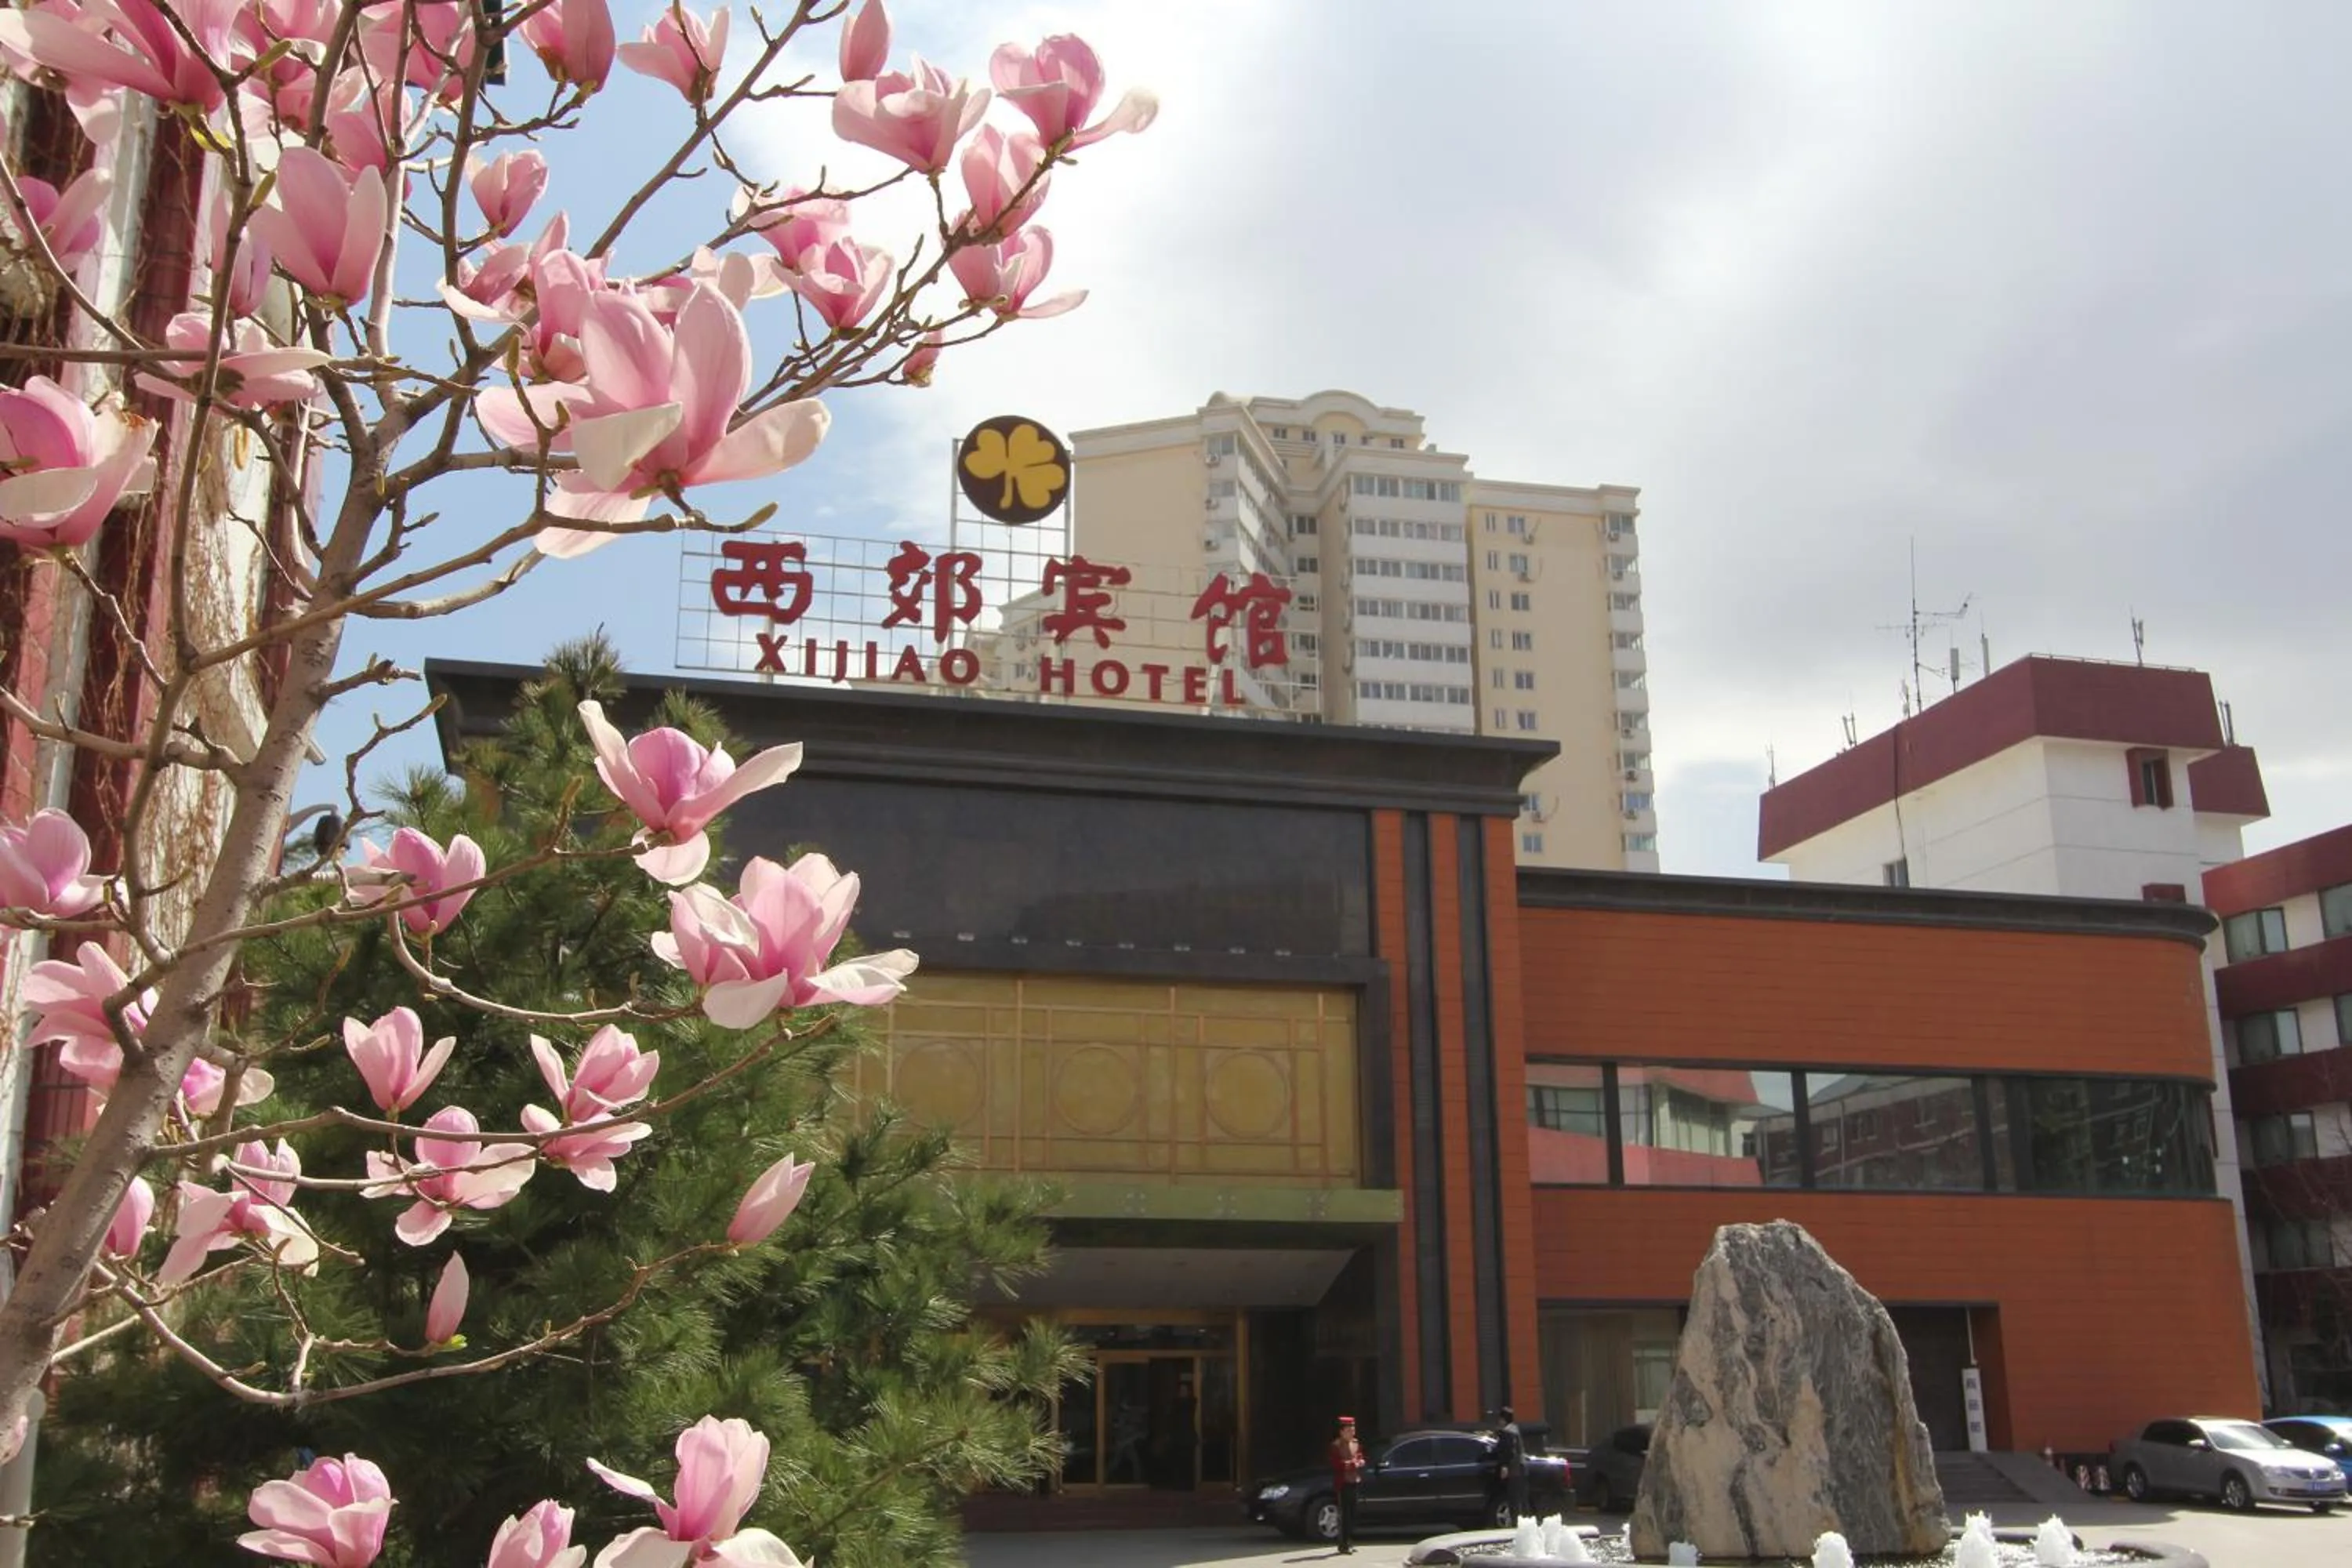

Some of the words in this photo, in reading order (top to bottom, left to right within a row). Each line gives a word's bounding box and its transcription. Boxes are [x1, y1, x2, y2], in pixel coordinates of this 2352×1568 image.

[712, 540, 1290, 667] 西郊宾馆
[754, 633, 980, 684] XIJIAO
[1040, 654, 1246, 705] HOTEL
